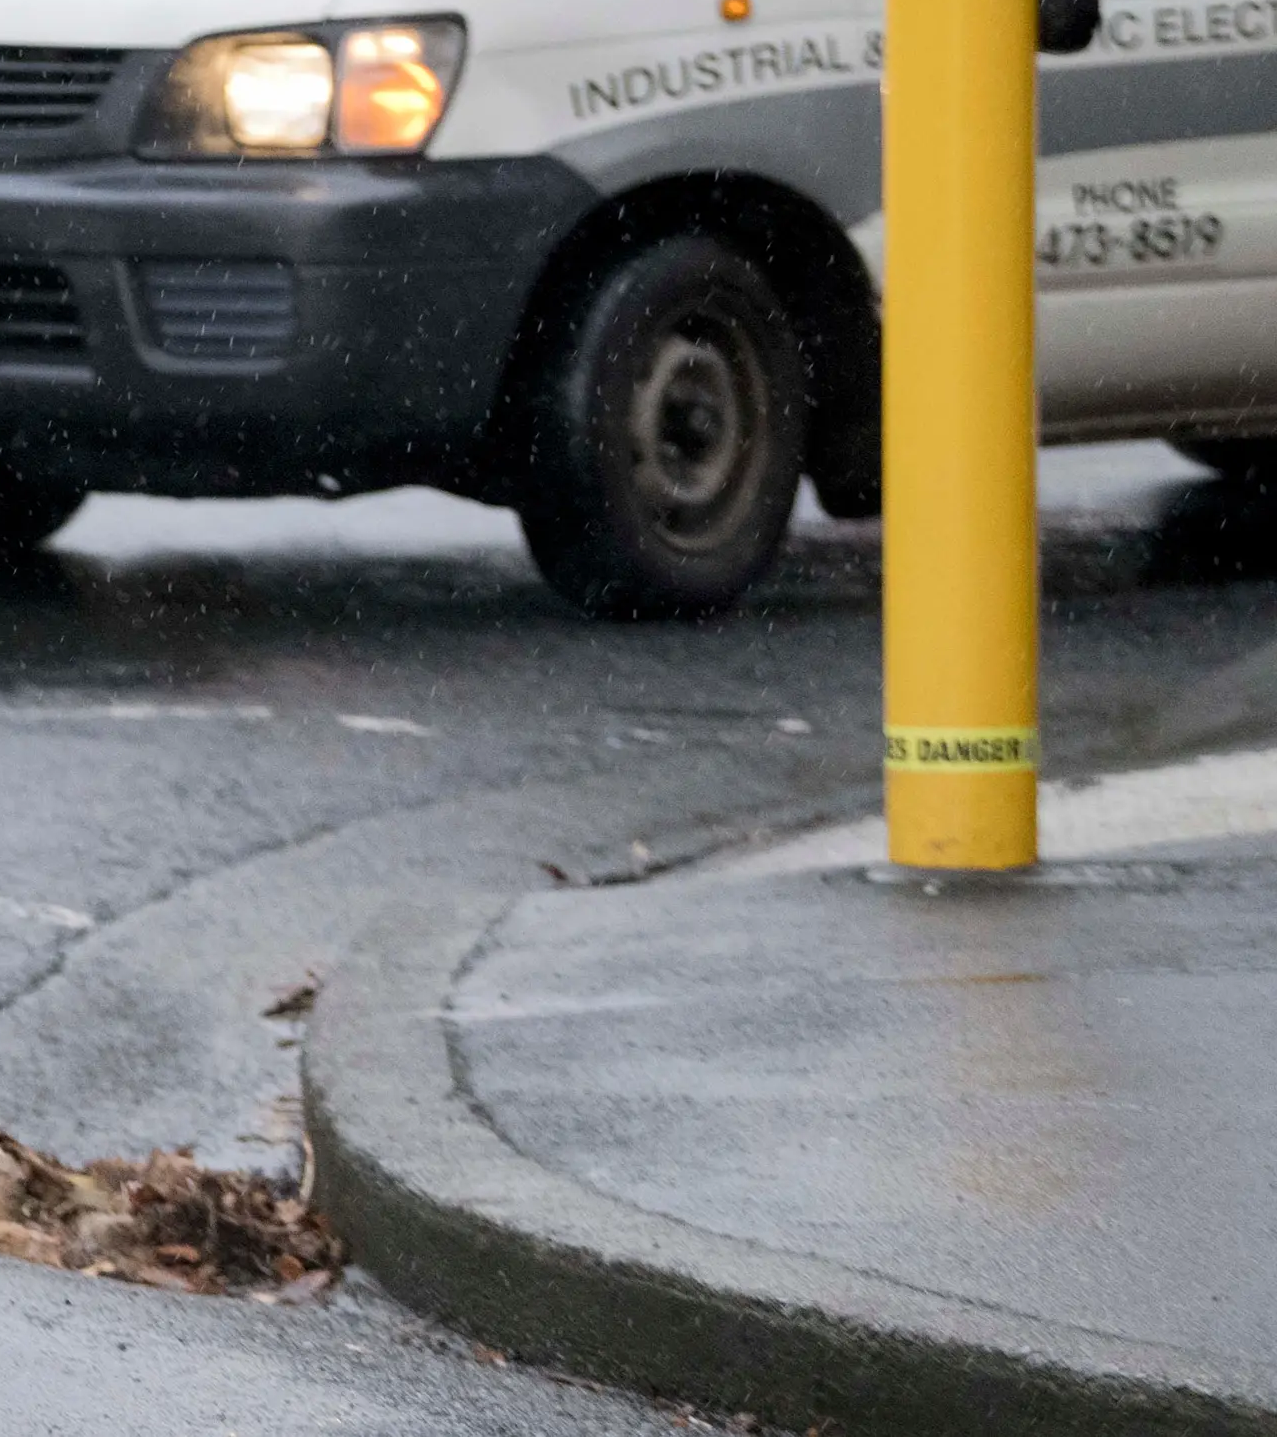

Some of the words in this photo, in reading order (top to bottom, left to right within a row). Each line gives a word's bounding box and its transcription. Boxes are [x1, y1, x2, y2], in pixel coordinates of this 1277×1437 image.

[567, 34, 851, 118] INDUSTRIAL
[862, 30, 886, 70] &
[1072, 176, 1179, 216] PHONE
[916, 736, 1022, 763] DANGER
